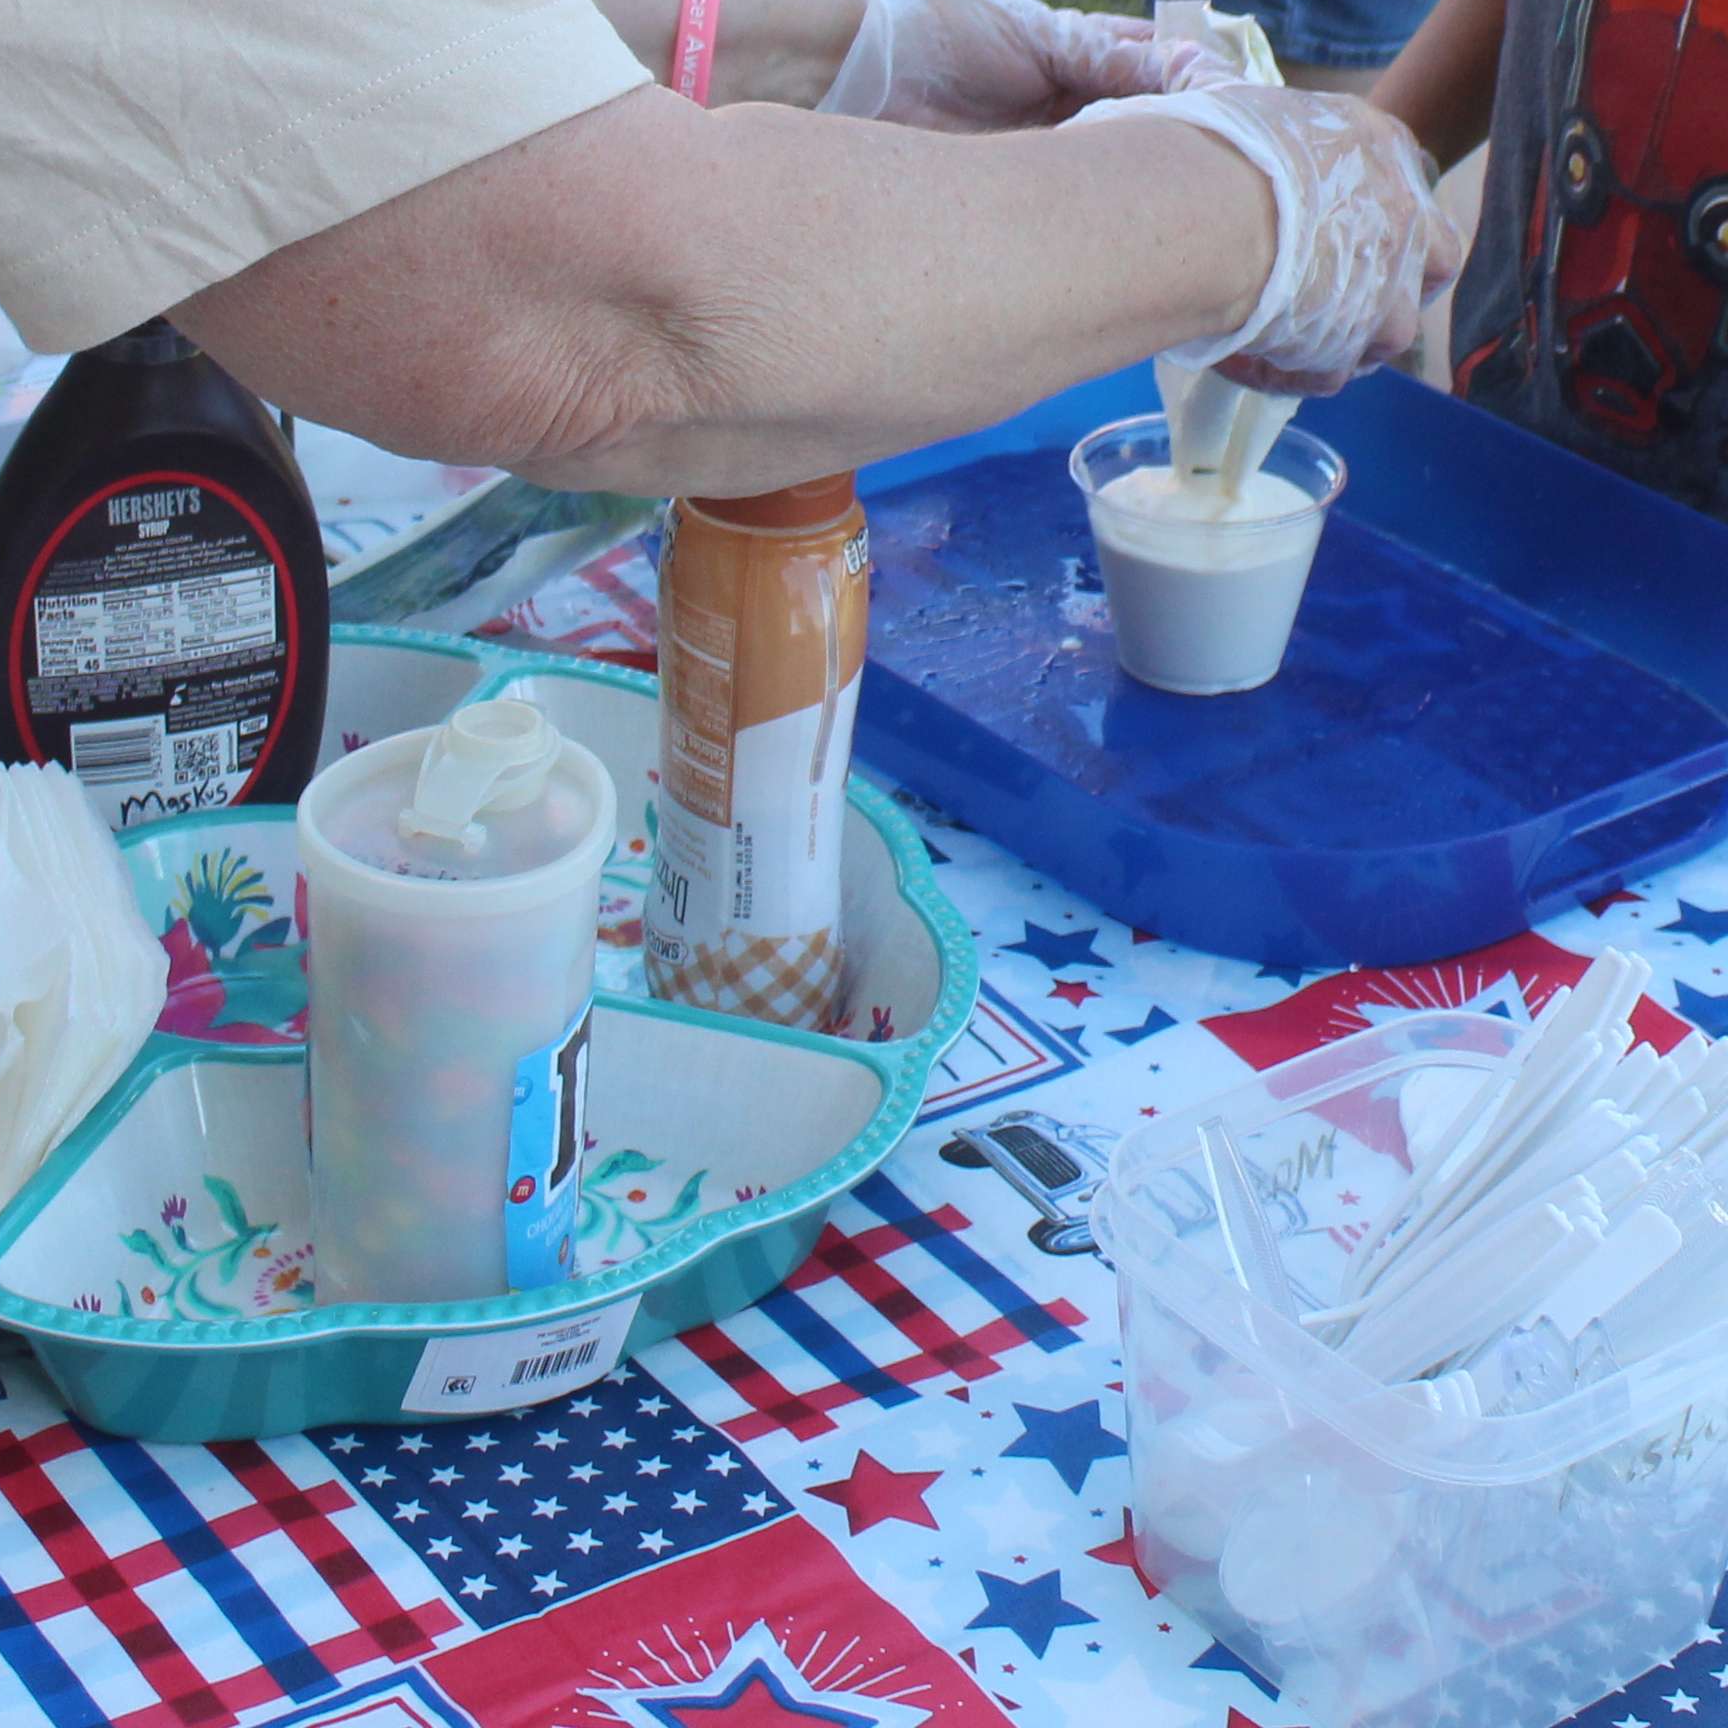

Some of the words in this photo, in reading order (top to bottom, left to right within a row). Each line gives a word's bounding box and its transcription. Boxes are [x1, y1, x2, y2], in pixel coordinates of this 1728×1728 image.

[108, 486, 201, 526] HERSHEY'S
[138, 520, 170, 539] SYRUP
[38, 595, 98, 609] Nutrition
[38, 609, 75, 622] Facts
[84, 657, 100, 671] 45
